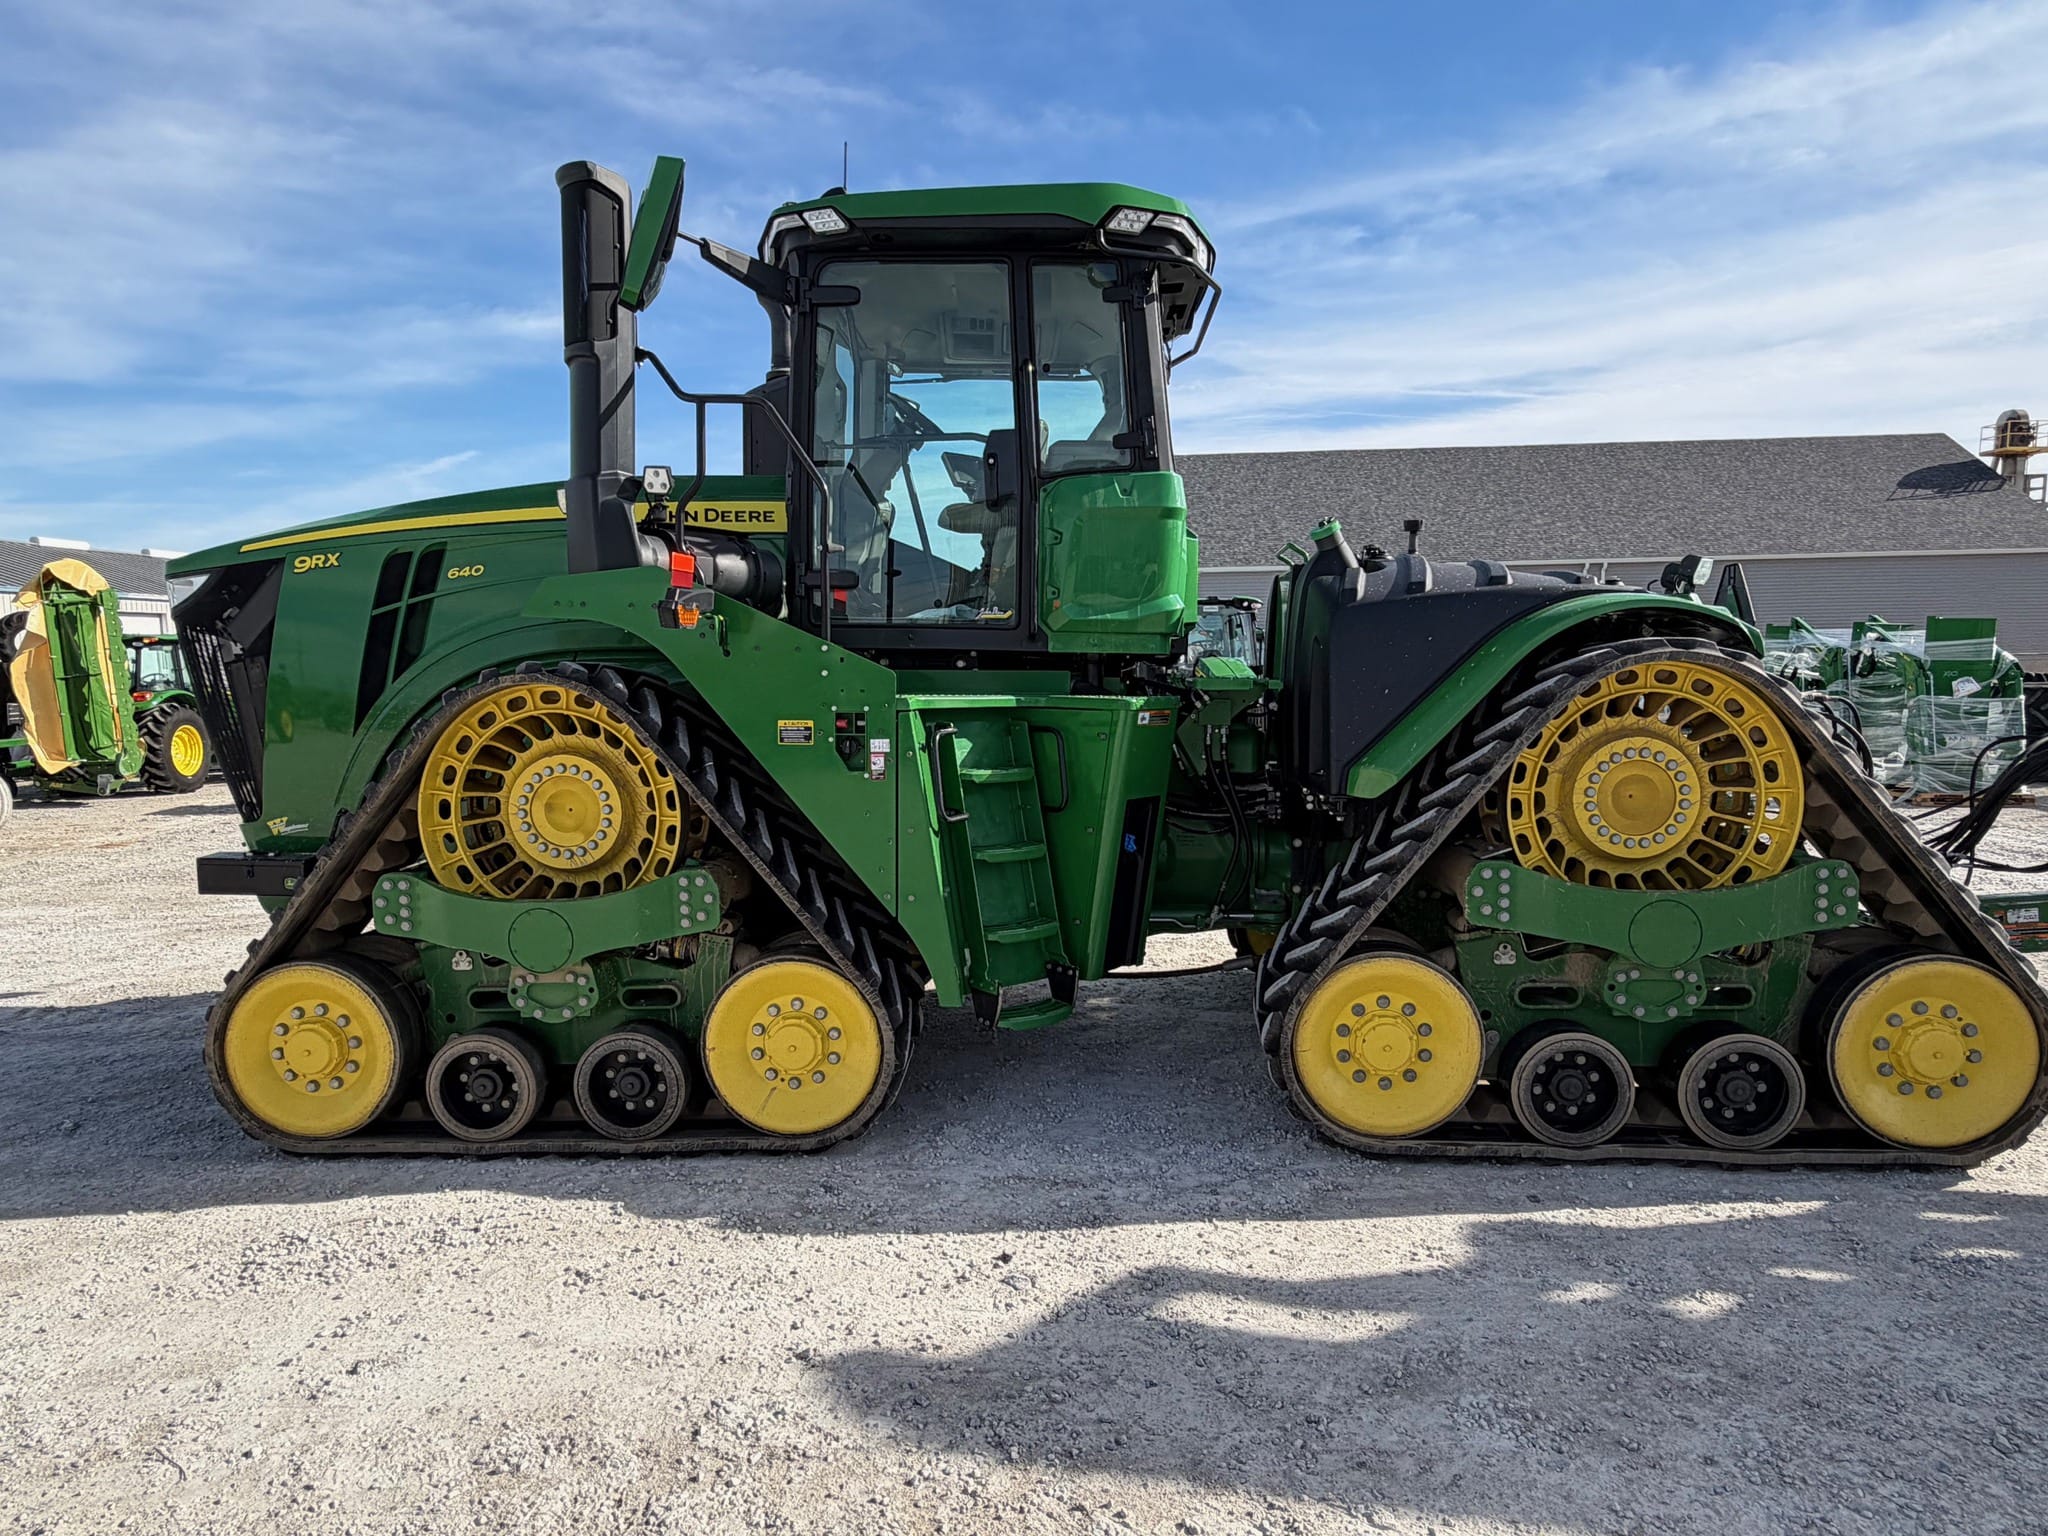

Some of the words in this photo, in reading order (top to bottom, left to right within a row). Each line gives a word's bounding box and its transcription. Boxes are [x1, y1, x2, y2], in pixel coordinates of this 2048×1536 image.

[704, 508, 775, 523] DEERE
[293, 552, 342, 573] 9RX
[447, 564, 485, 579] 640
